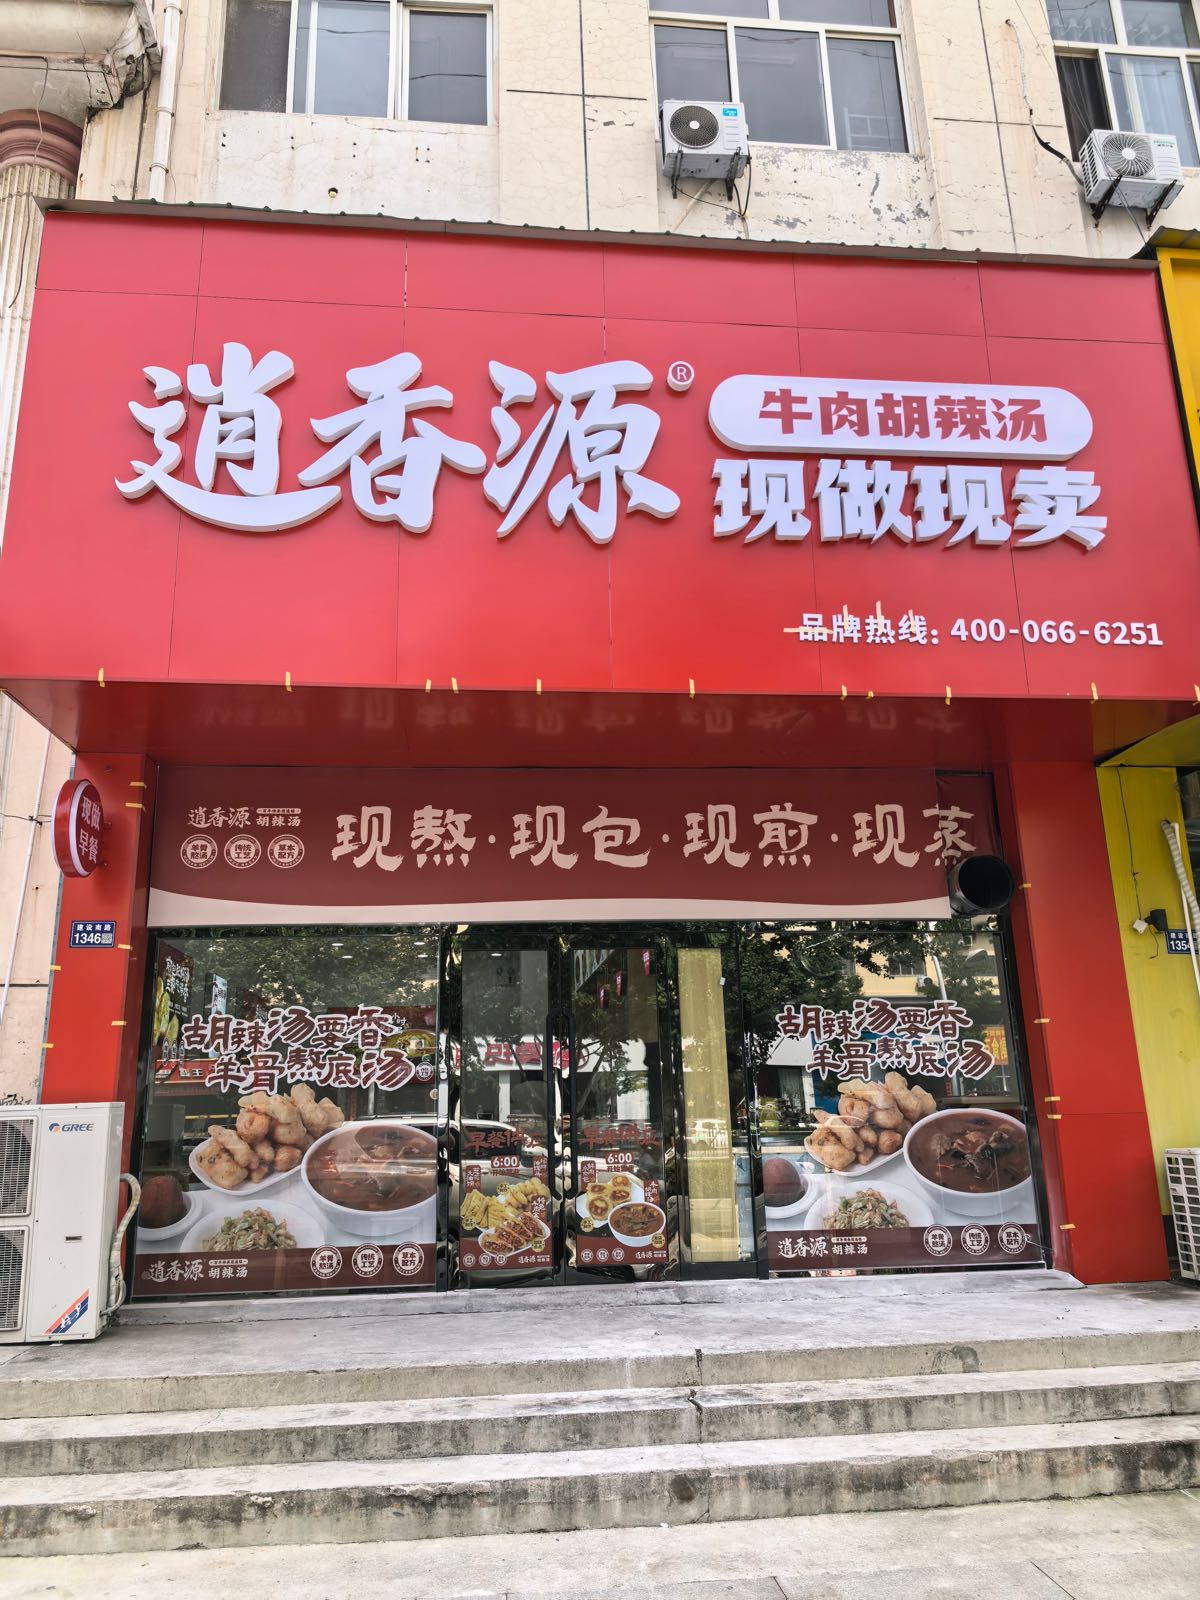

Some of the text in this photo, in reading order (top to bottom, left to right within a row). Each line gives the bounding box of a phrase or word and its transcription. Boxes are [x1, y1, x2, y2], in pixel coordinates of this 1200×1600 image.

[758, 388, 1048, 442] 牛肉胡辣汤
[114, 341, 682, 545] 逍香源
[711, 458, 1108, 551] 现做现卖
[951, 618, 1164, 646] 400-066-6251
[187, 806, 252, 828] 逍香源
[256, 816, 301, 827] 胡辣汤
[79, 828, 98, 863] 早餐
[74, 932, 101, 944] 1346
[182, 1004, 400, 1054] 胡辣汤要香
[777, 998, 973, 1042] 胡辣汤要香
[806, 1037, 994, 1081] 羊骨熬底汤
[205, 1047, 415, 1095] 羊骨熬底汤
[61, 1123, 94, 1132] GREE
[493, 1156, 518, 1167] 6:00
[607, 1153, 632, 1163] 6:00
[778, 1236, 828, 1258] 逍香源
[832, 1243, 868, 1255] 胡辣汤
[149, 1259, 204, 1282] 逍香源
[208, 1266, 248, 1279] 胡辣汤
